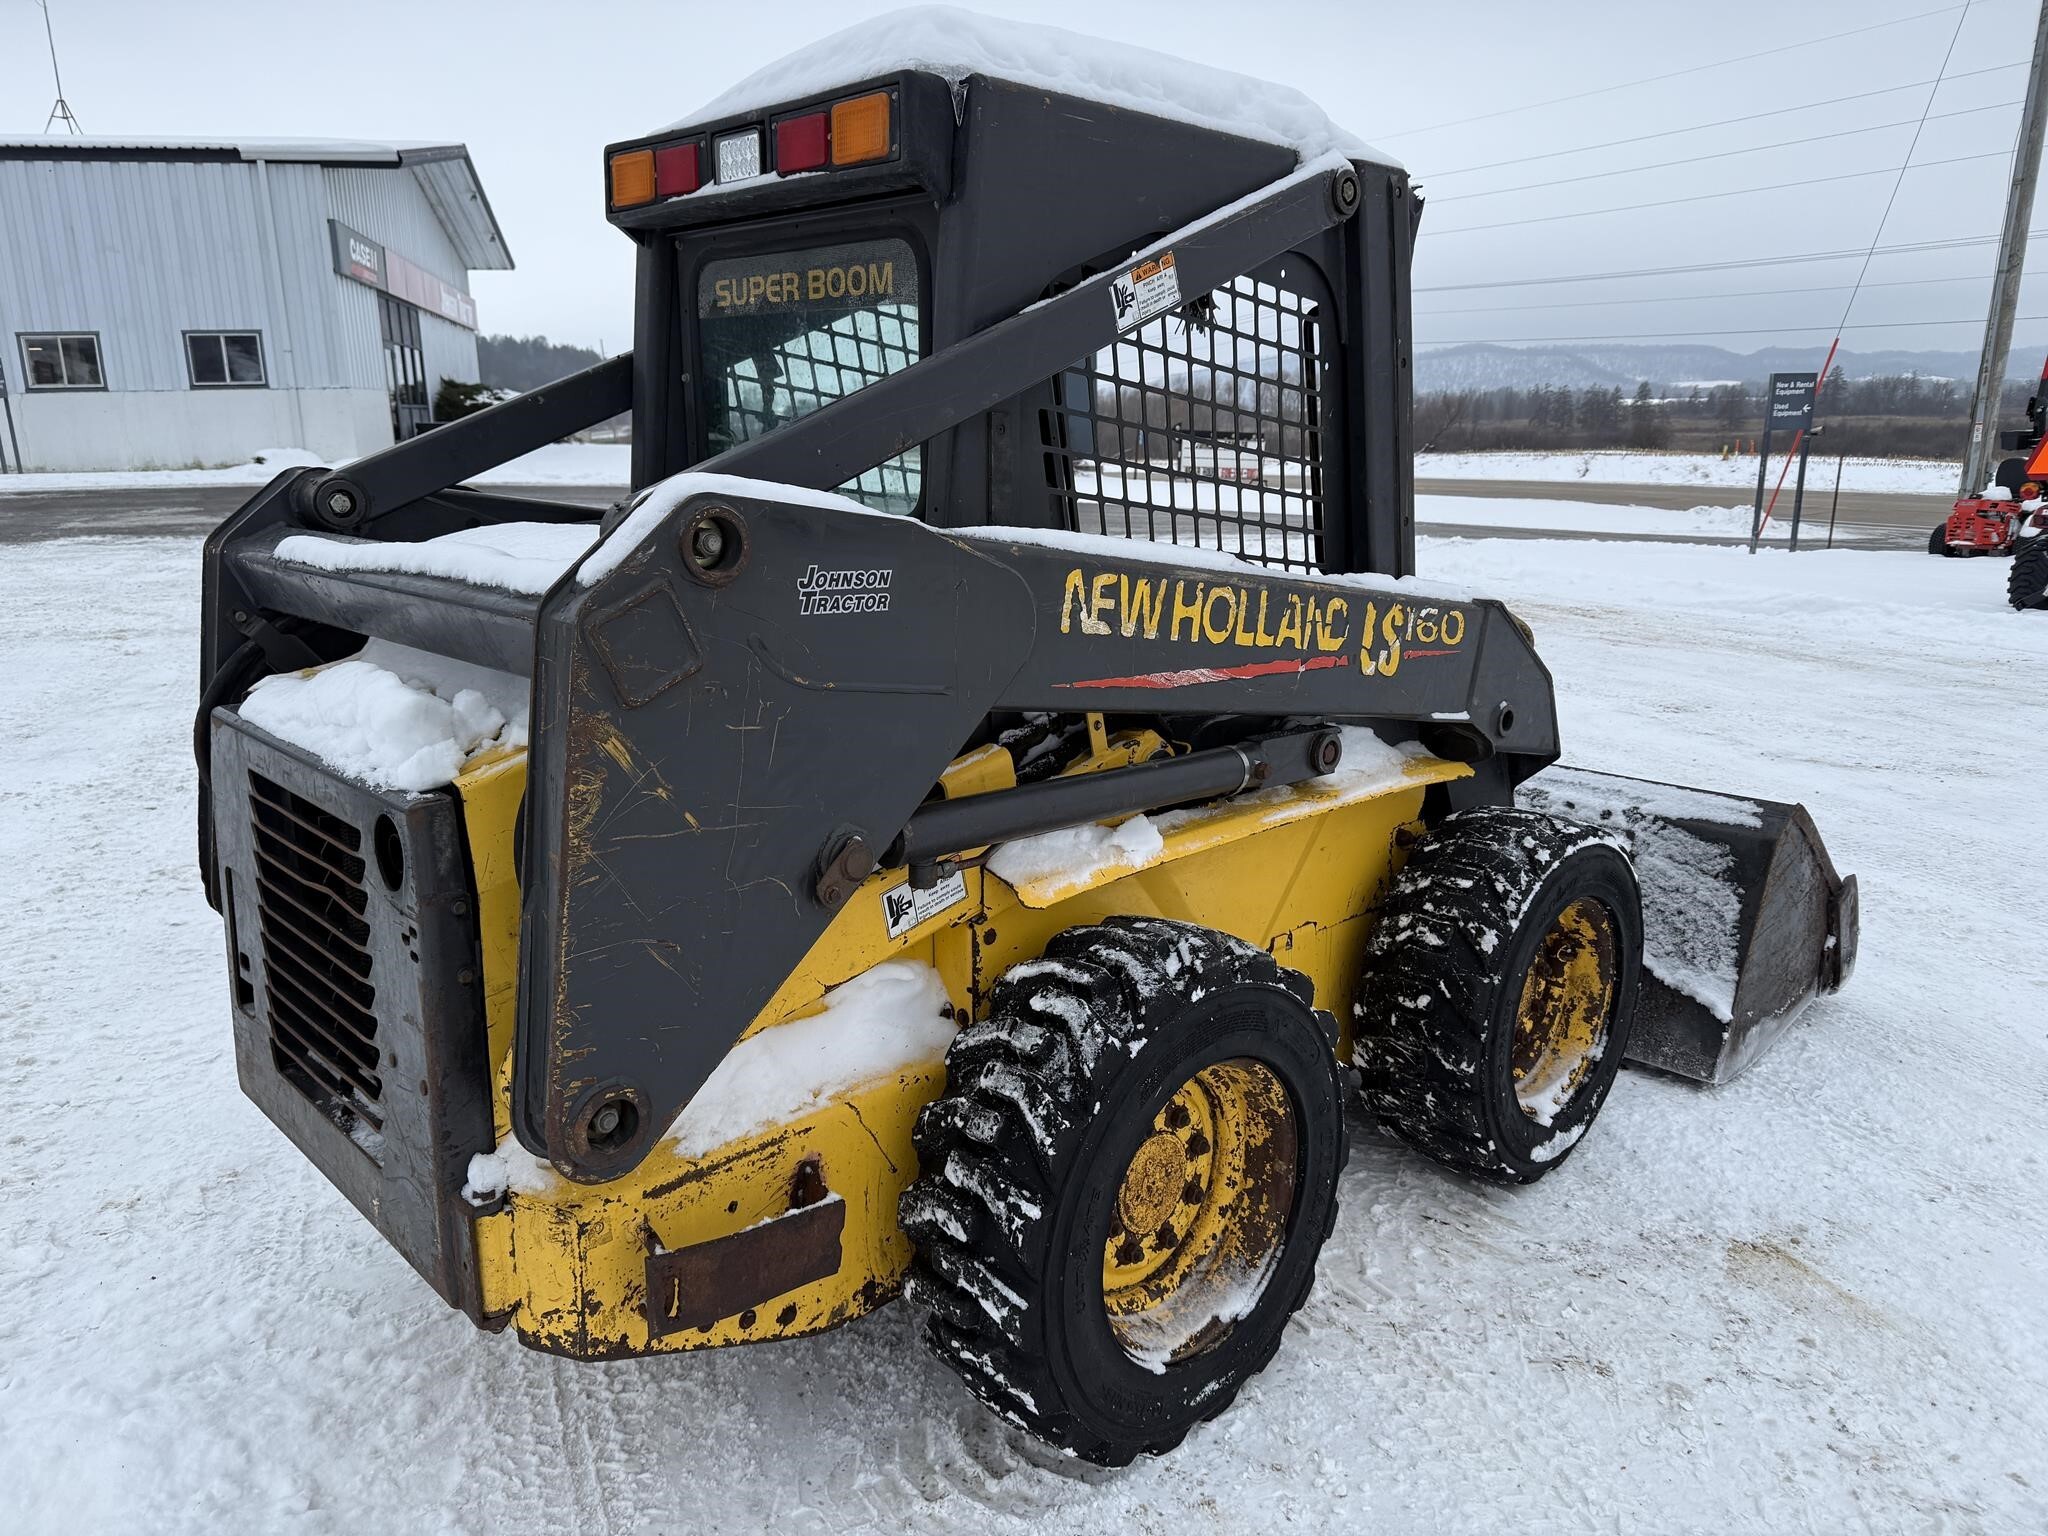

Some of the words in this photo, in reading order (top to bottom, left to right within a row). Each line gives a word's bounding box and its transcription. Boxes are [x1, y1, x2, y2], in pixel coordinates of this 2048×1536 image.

[715, 271, 800, 307] SUPER
[808, 261, 894, 300] BOOM
[1775, 388, 1805, 396] Equipment
[797, 564, 892, 591] JOHNSON
[799, 589, 890, 615] TRACTOR
[1060, 568, 1169, 640] NEW
